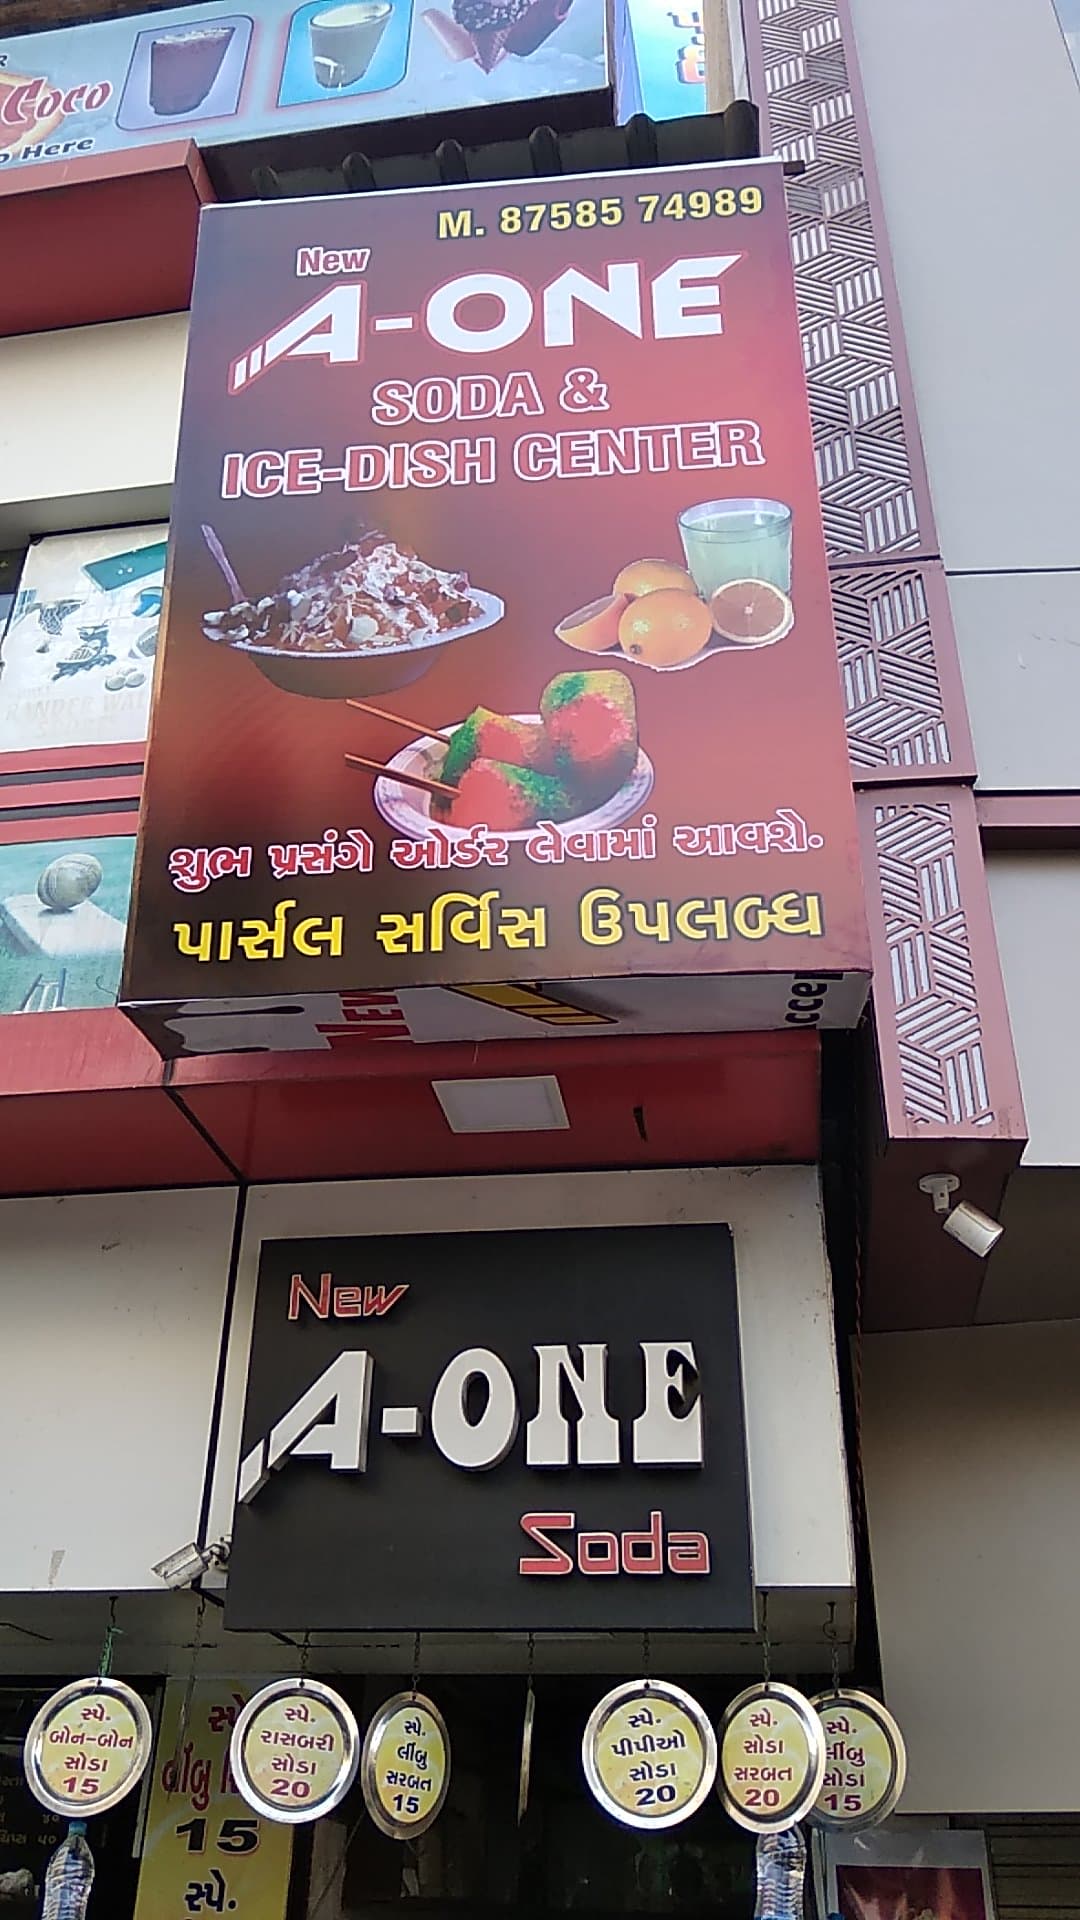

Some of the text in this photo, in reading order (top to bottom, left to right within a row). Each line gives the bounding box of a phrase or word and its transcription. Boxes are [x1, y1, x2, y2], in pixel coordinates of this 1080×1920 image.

[3, 77, 112, 124] Coco
[21, 139, 94, 160] Here
[438, 186, 763, 240] M. 87585 74989
[296, 246, 371, 277] New
[231, 252, 744, 391] A-ONE
[371, 367, 610, 426] SODA &
[221, 420, 766, 499] ICE-DISH CENTER
[168, 808, 824, 892] શુભ પ્રસંગે ઓર્ડર લેવામાં આવશે.
[173, 888, 823, 962] પાર્સલ સર્વિસ ઉપલબ્ધ
[288, 1272, 410, 1321] New
[237, 1341, 704, 1504] A-ONE
[519, 1511, 710, 1575] Soda
[81, 1703, 111, 1721] સ્પે.
[284, 1703, 316, 1722] સ્પે.
[628, 1707, 661, 1728] સ્પે.
[749, 1707, 778, 1727] સ્પે.
[404, 1716, 427, 1737] સ્પે.
[826, 1715, 858, 1735] સ્પે.
[49, 1725, 134, 1749] બોન-બોન
[260, 1730, 335, 1752] રાસબરી
[611, 1729, 686, 1756] પીપીઓ
[743, 1734, 784, 1755] સોડા
[64, 1751, 108, 1772] સોડા
[271, 1752, 316, 1775] સોડા
[629, 1760, 676, 1781] સોડા
[386, 1770, 432, 1792] સરબત
[733, 1766, 793, 1781] સરબત
[823, 1767, 865, 1787] સોડા
[63, 1776, 99, 1795] 15
[270, 1778, 311, 1798] 20
[635, 1784, 676, 1806] 20
[393, 1794, 420, 1814] 15
[744, 1788, 780, 1807] 20
[824, 1794, 863, 1811] 15
[175, 1817, 260, 1853] 15
[184, 1868, 237, 1912] સ્પે.
